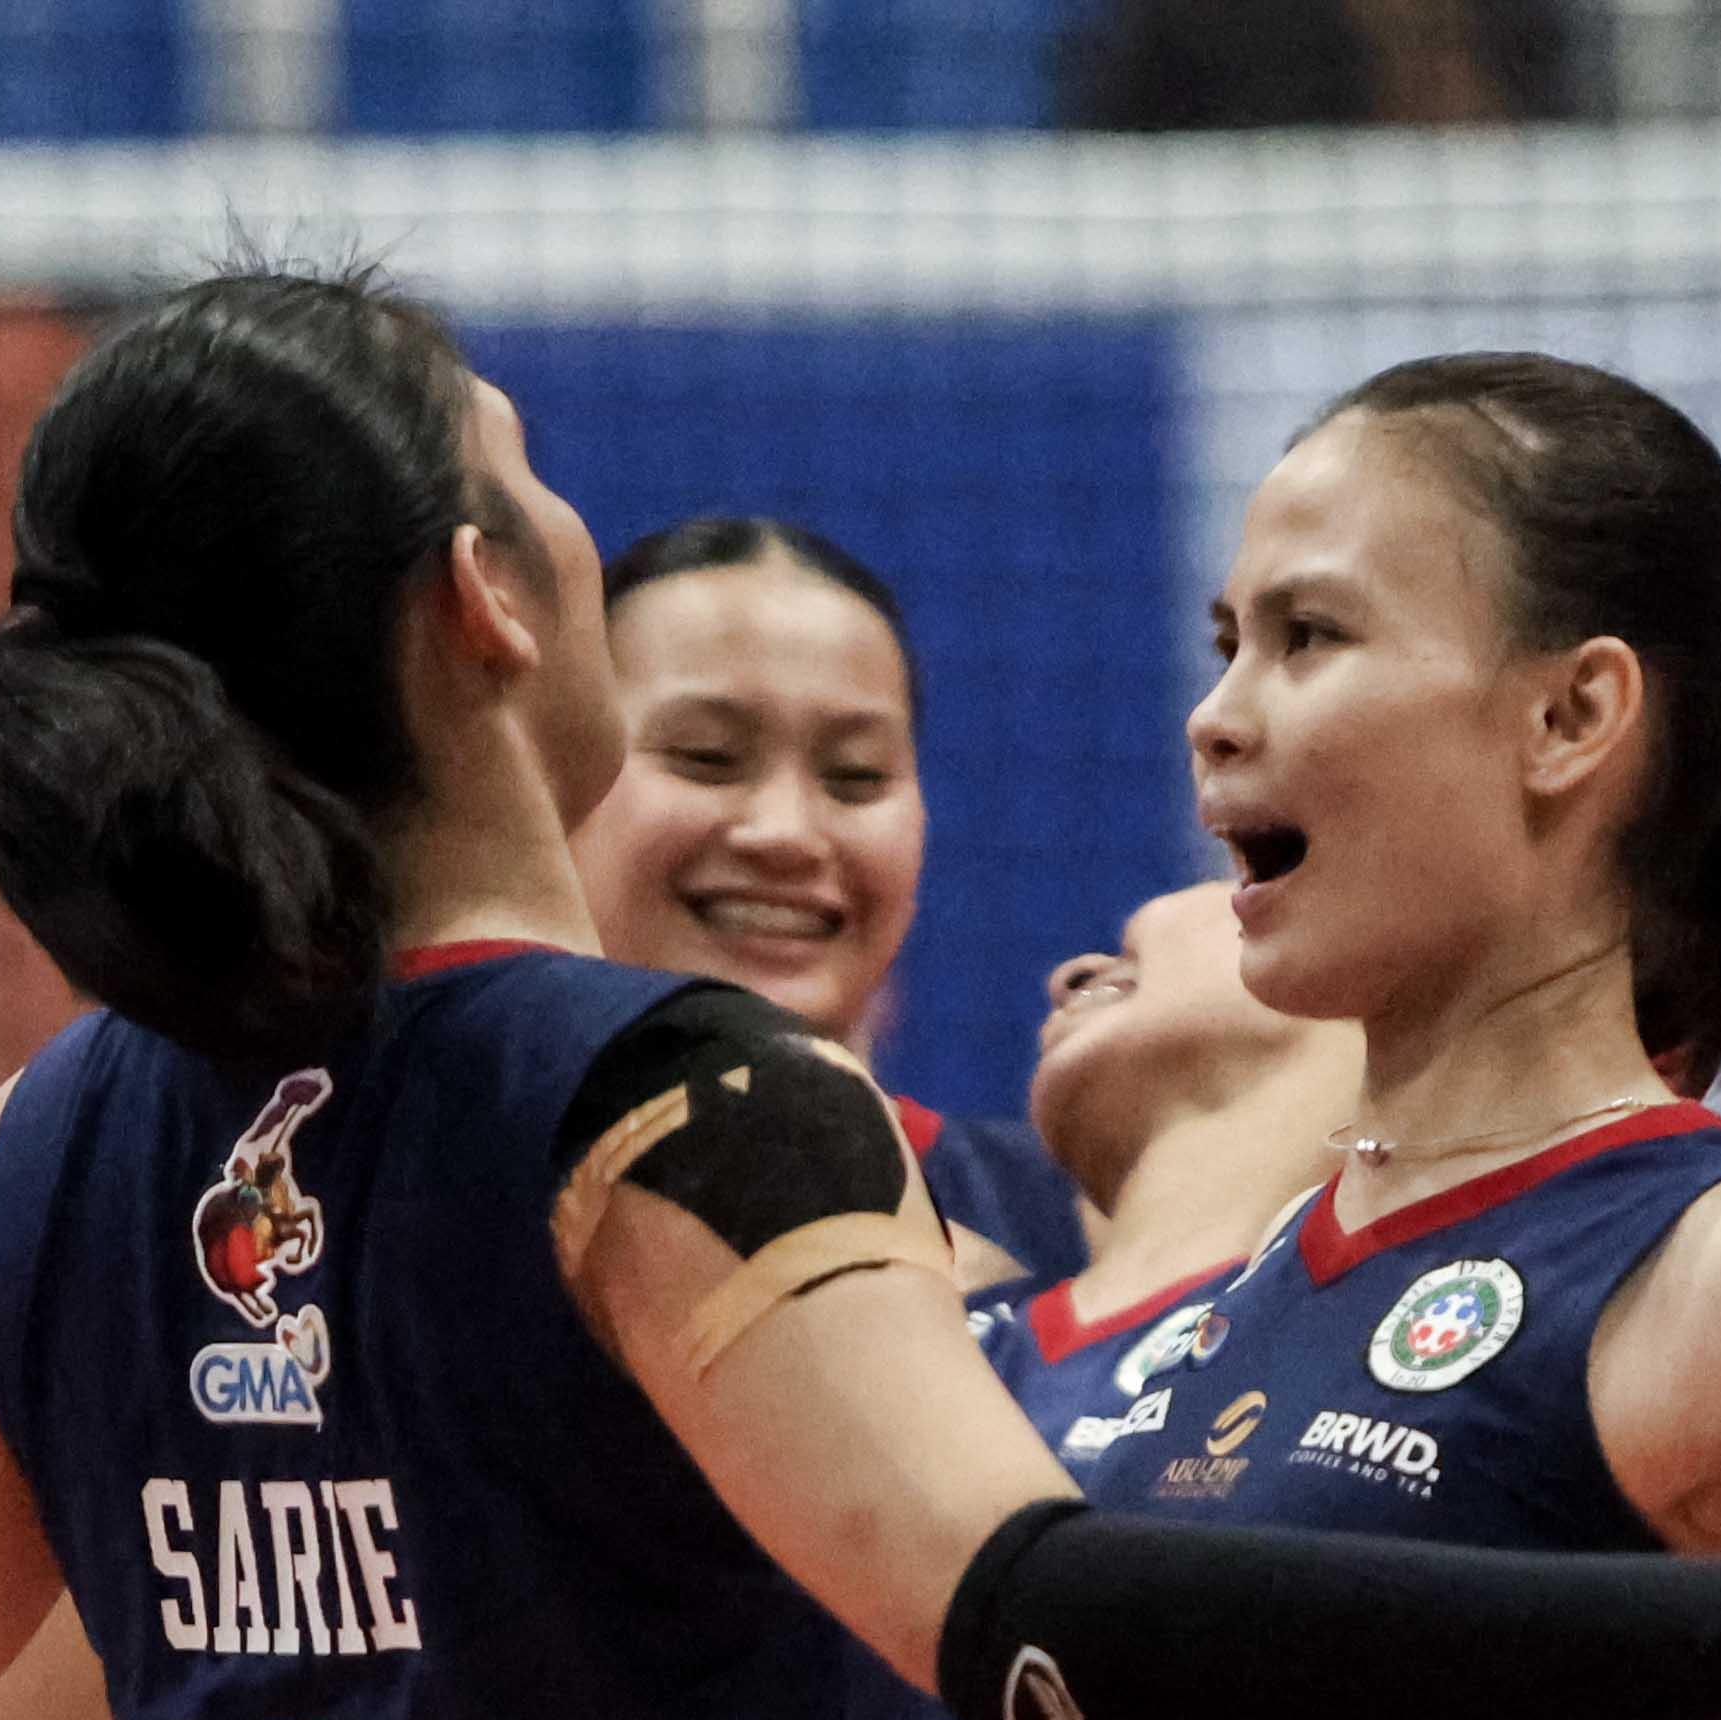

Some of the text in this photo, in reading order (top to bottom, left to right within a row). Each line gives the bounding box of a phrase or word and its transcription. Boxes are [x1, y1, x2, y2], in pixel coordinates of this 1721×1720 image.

[198, 1354, 313, 1413] GMA
[1300, 1411, 1440, 1482] BRWD.
[1348, 1461, 1388, 1481] AND
[1397, 1475, 1432, 1498] TEA
[141, 1477, 422, 1656] SARIE
